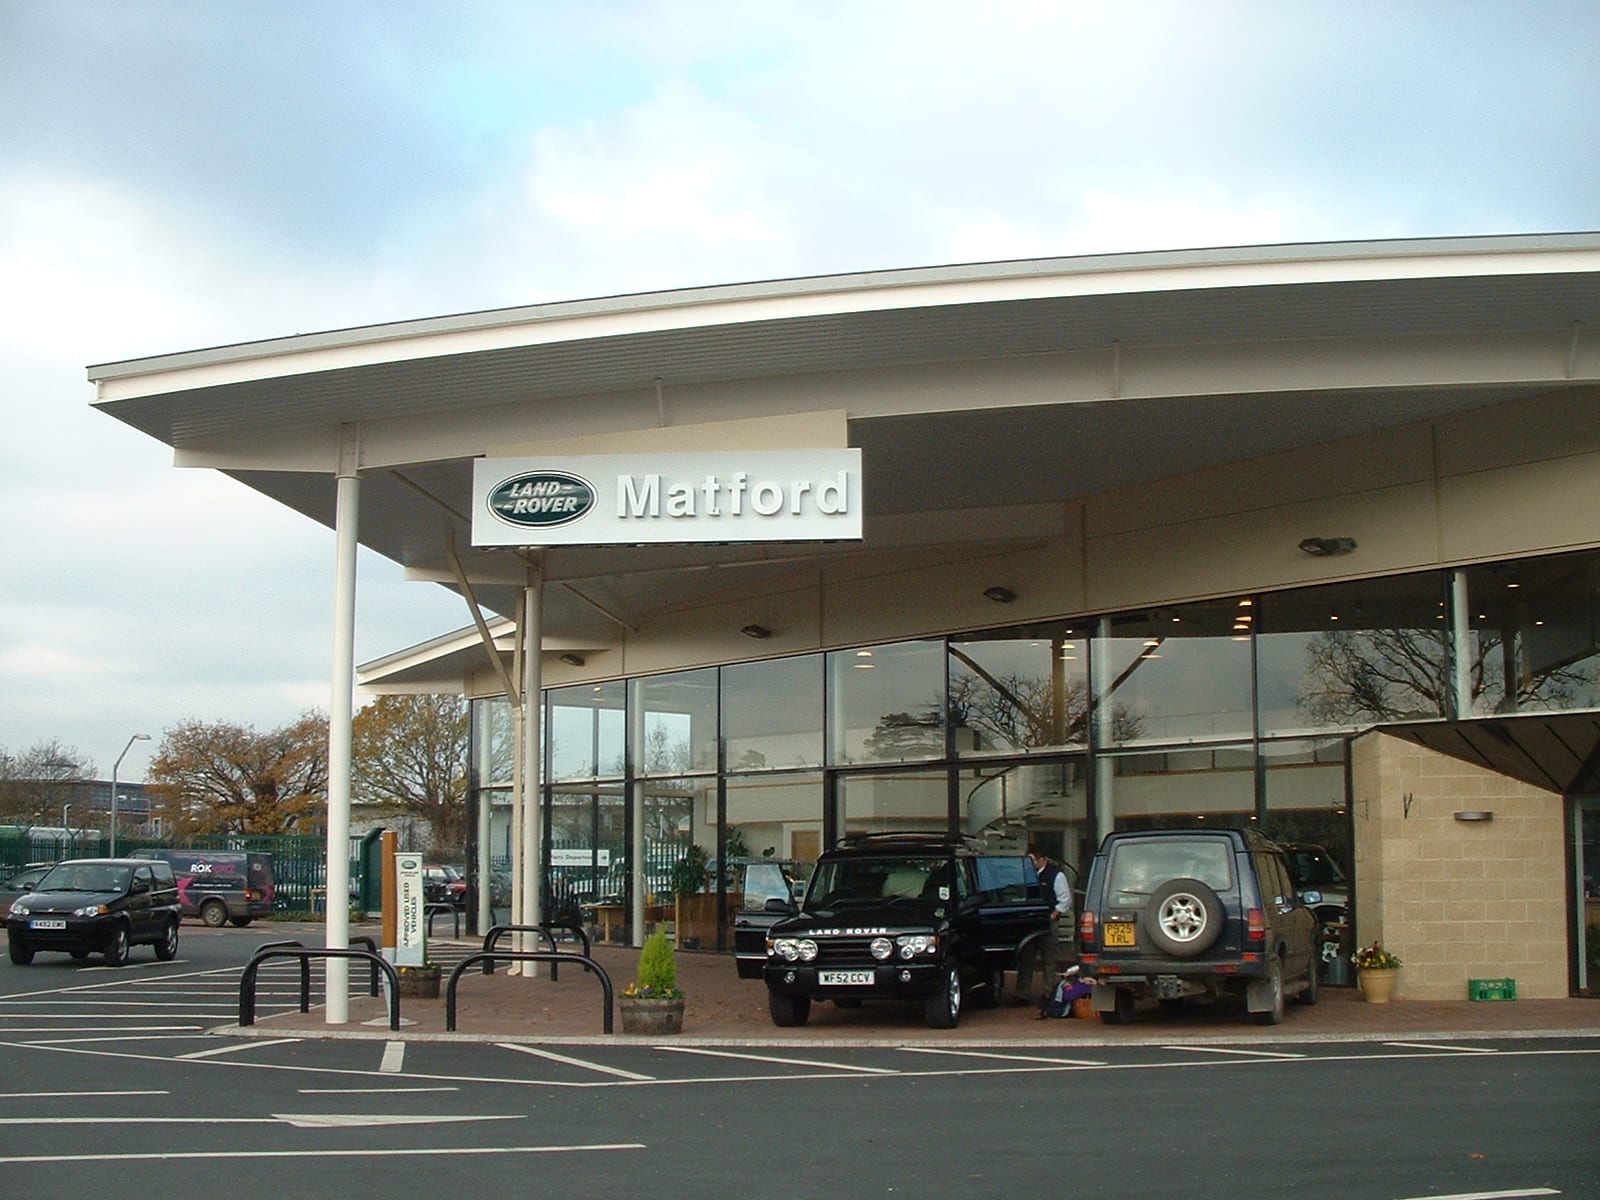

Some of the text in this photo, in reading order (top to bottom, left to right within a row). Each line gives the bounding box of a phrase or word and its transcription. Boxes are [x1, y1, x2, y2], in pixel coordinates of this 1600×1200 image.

[509, 481, 561, 498] LAND
[616, 471, 849, 518] Matford
[513, 496, 578, 514] ROVER
[808, 927, 887, 936] LAND ROVER
[1110, 934, 1129, 944] TRL
[822, 973, 871, 983] WF52 CCV
